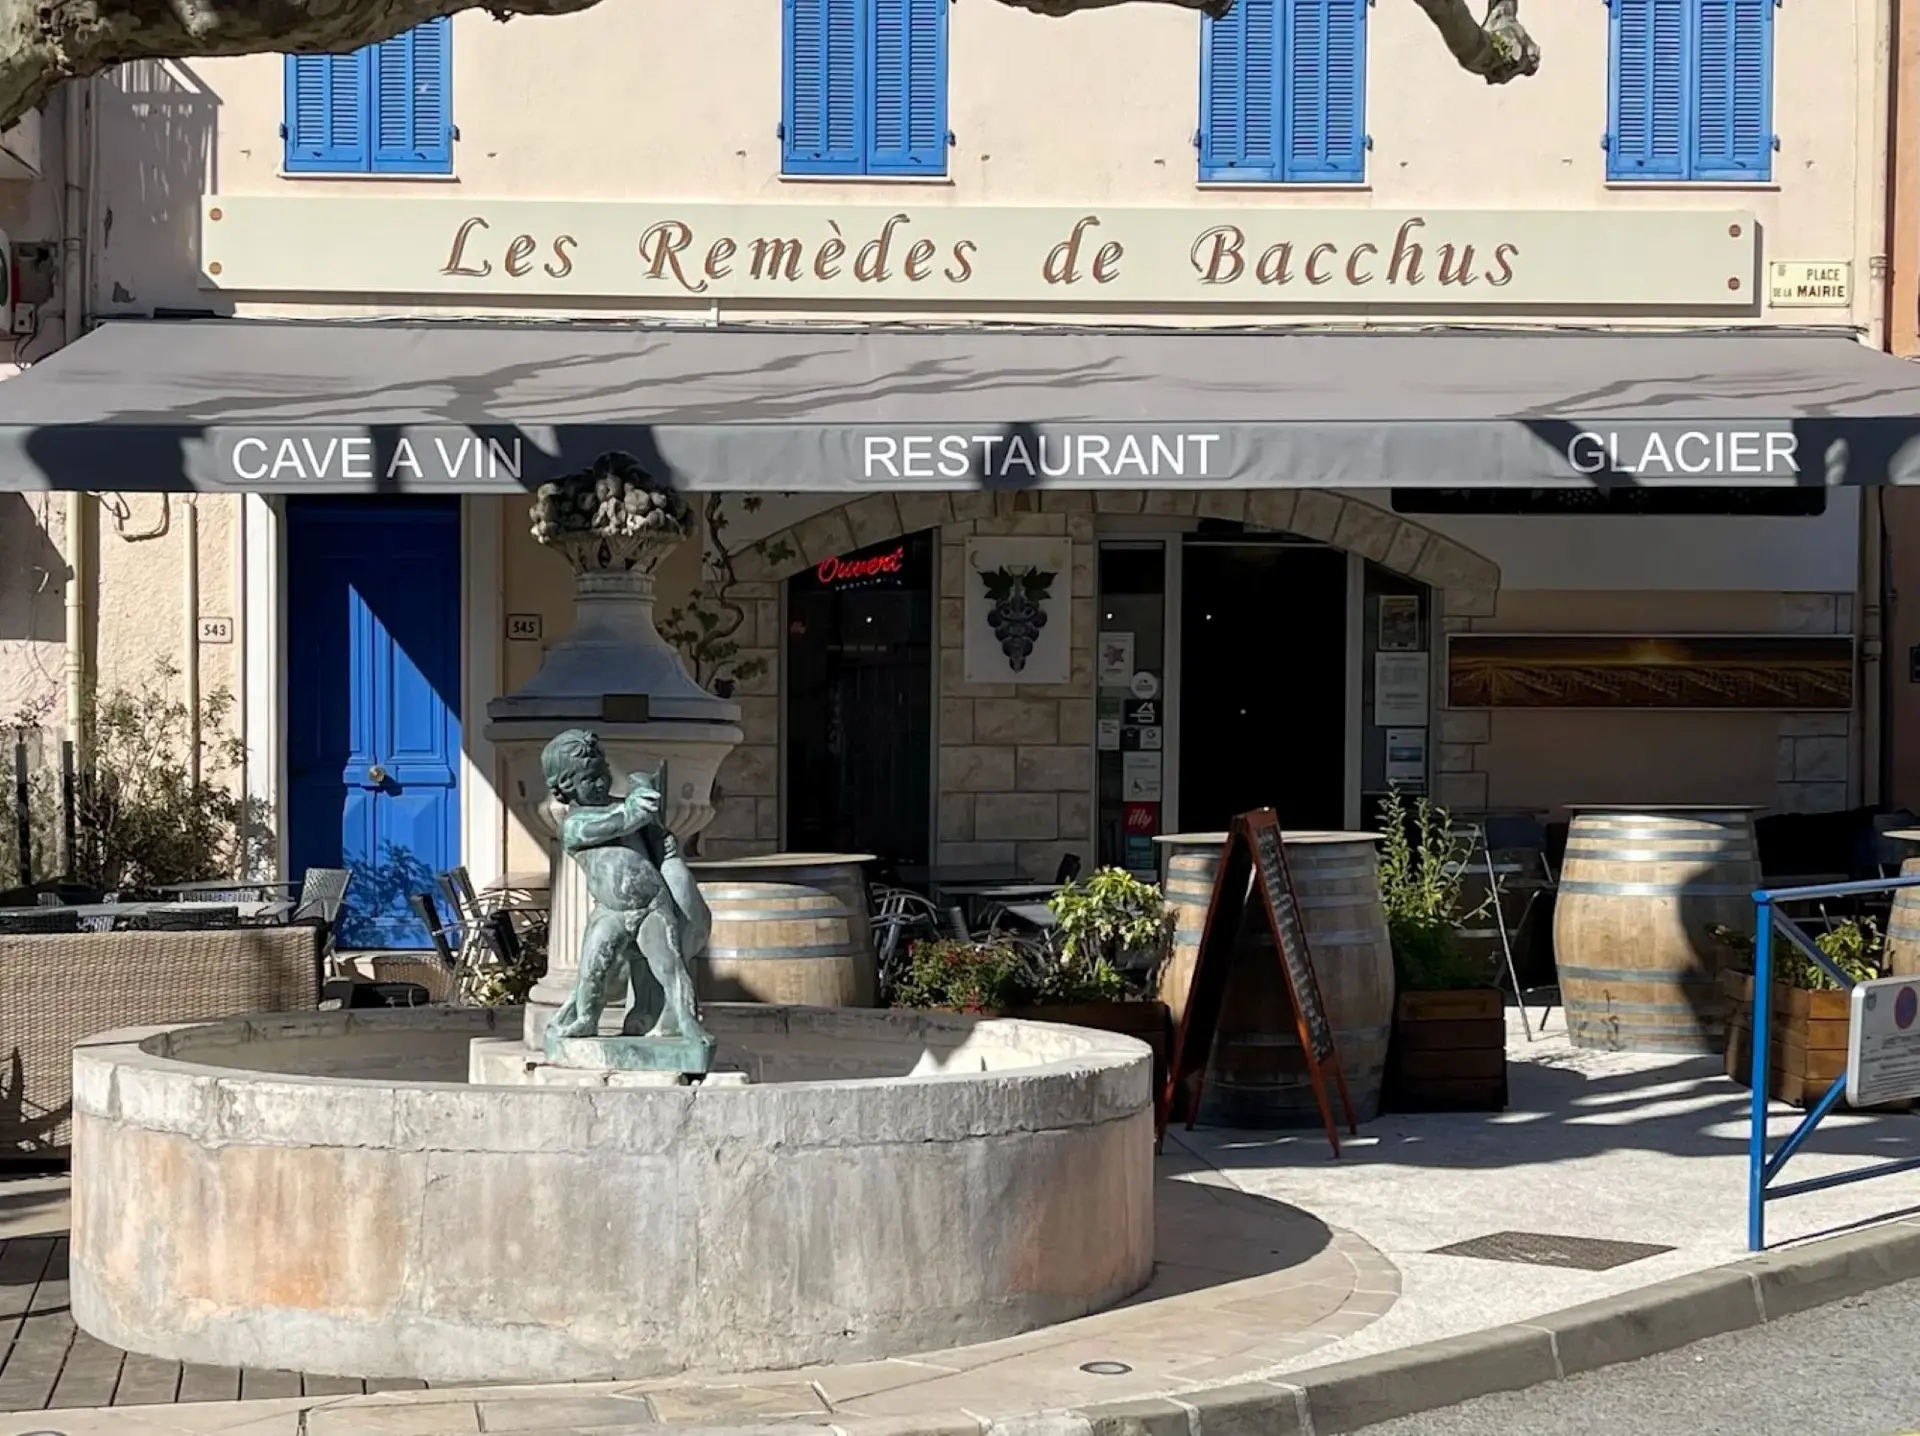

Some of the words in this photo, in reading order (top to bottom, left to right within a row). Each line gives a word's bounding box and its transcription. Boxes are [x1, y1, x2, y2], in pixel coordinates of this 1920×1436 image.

[439, 217, 578, 278] Les
[640, 213, 977, 293] Remèdes
[1043, 215, 1124, 285] de
[1190, 217, 1519, 287] Bacchus
[1806, 268, 1840, 281] PLACE
[1797, 285, 1845, 297] MAIRIE
[232, 437, 372, 479] CAVE
[386, 438, 422, 479] A
[433, 437, 522, 478] VIN
[864, 434, 1219, 476] RESTAURANT
[1568, 431, 1800, 473] GLACIER
[817, 545, 904, 584] Ouvert
[204, 624, 226, 636] 543
[512, 621, 535, 633] 545
[1128, 808, 1152, 829] illy
